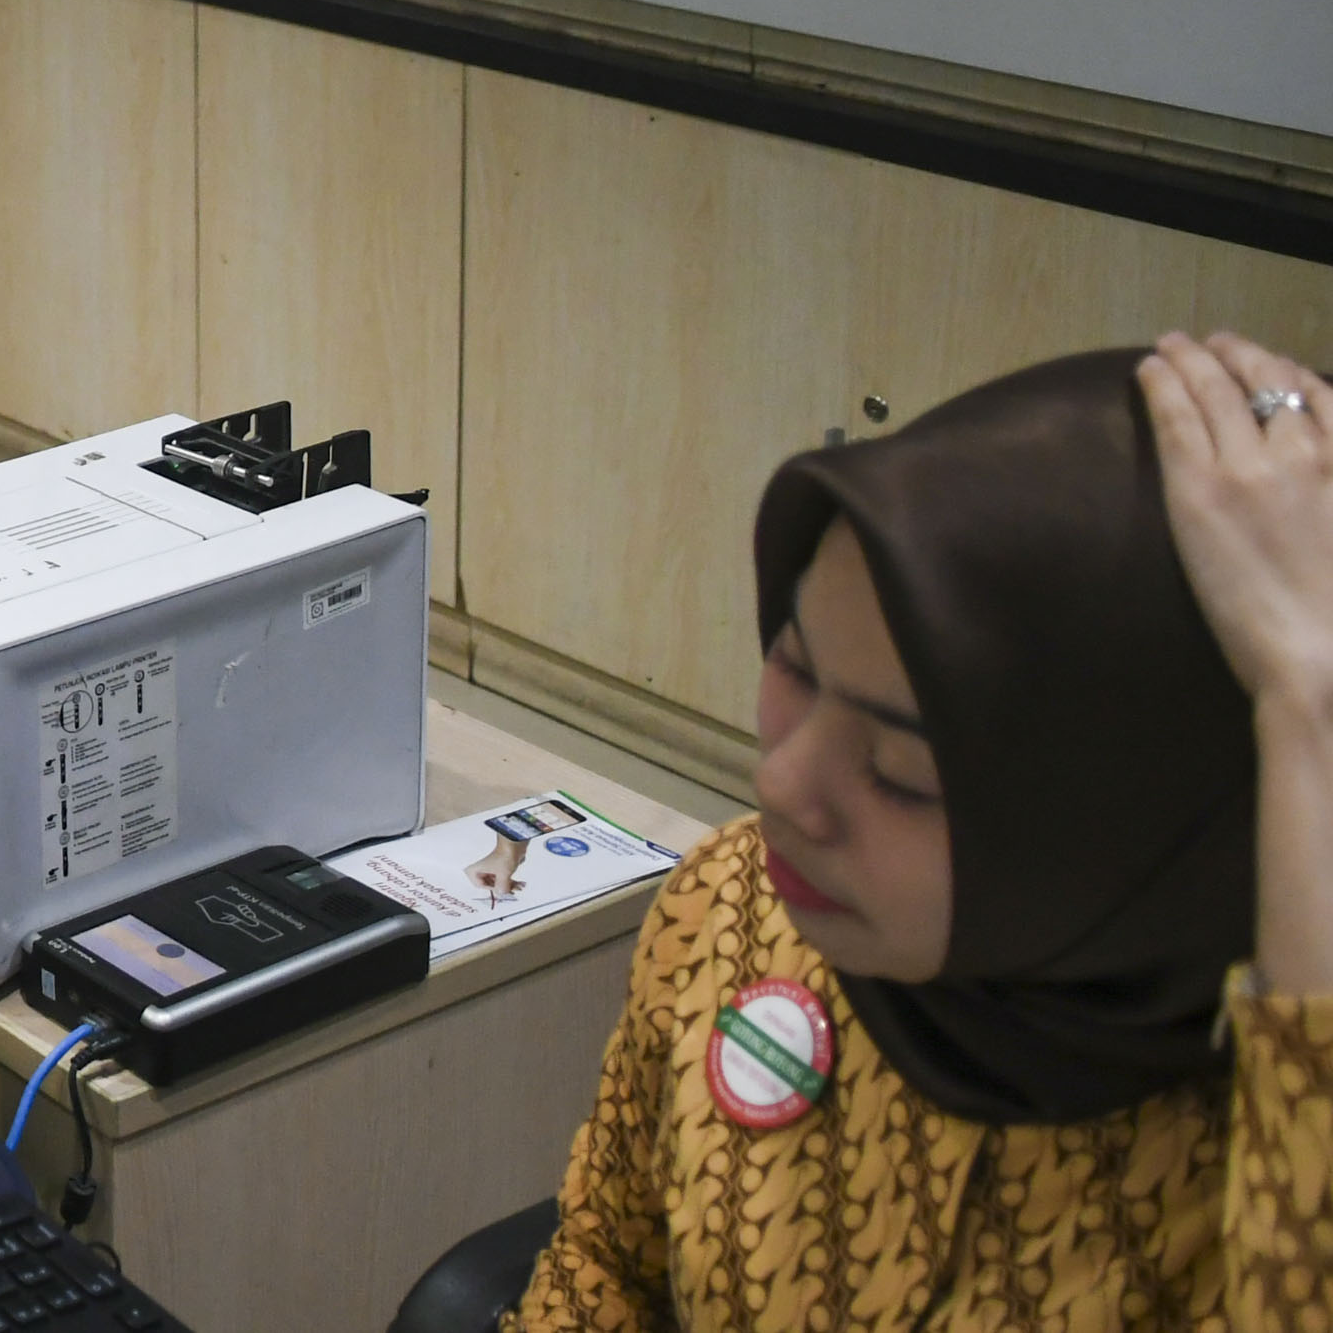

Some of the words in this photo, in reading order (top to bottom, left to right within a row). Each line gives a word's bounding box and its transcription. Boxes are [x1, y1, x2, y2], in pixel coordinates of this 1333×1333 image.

[407, 888, 450, 912] kantor
[415, 879, 447, 899] gak
[438, 892, 478, 914] sudah
